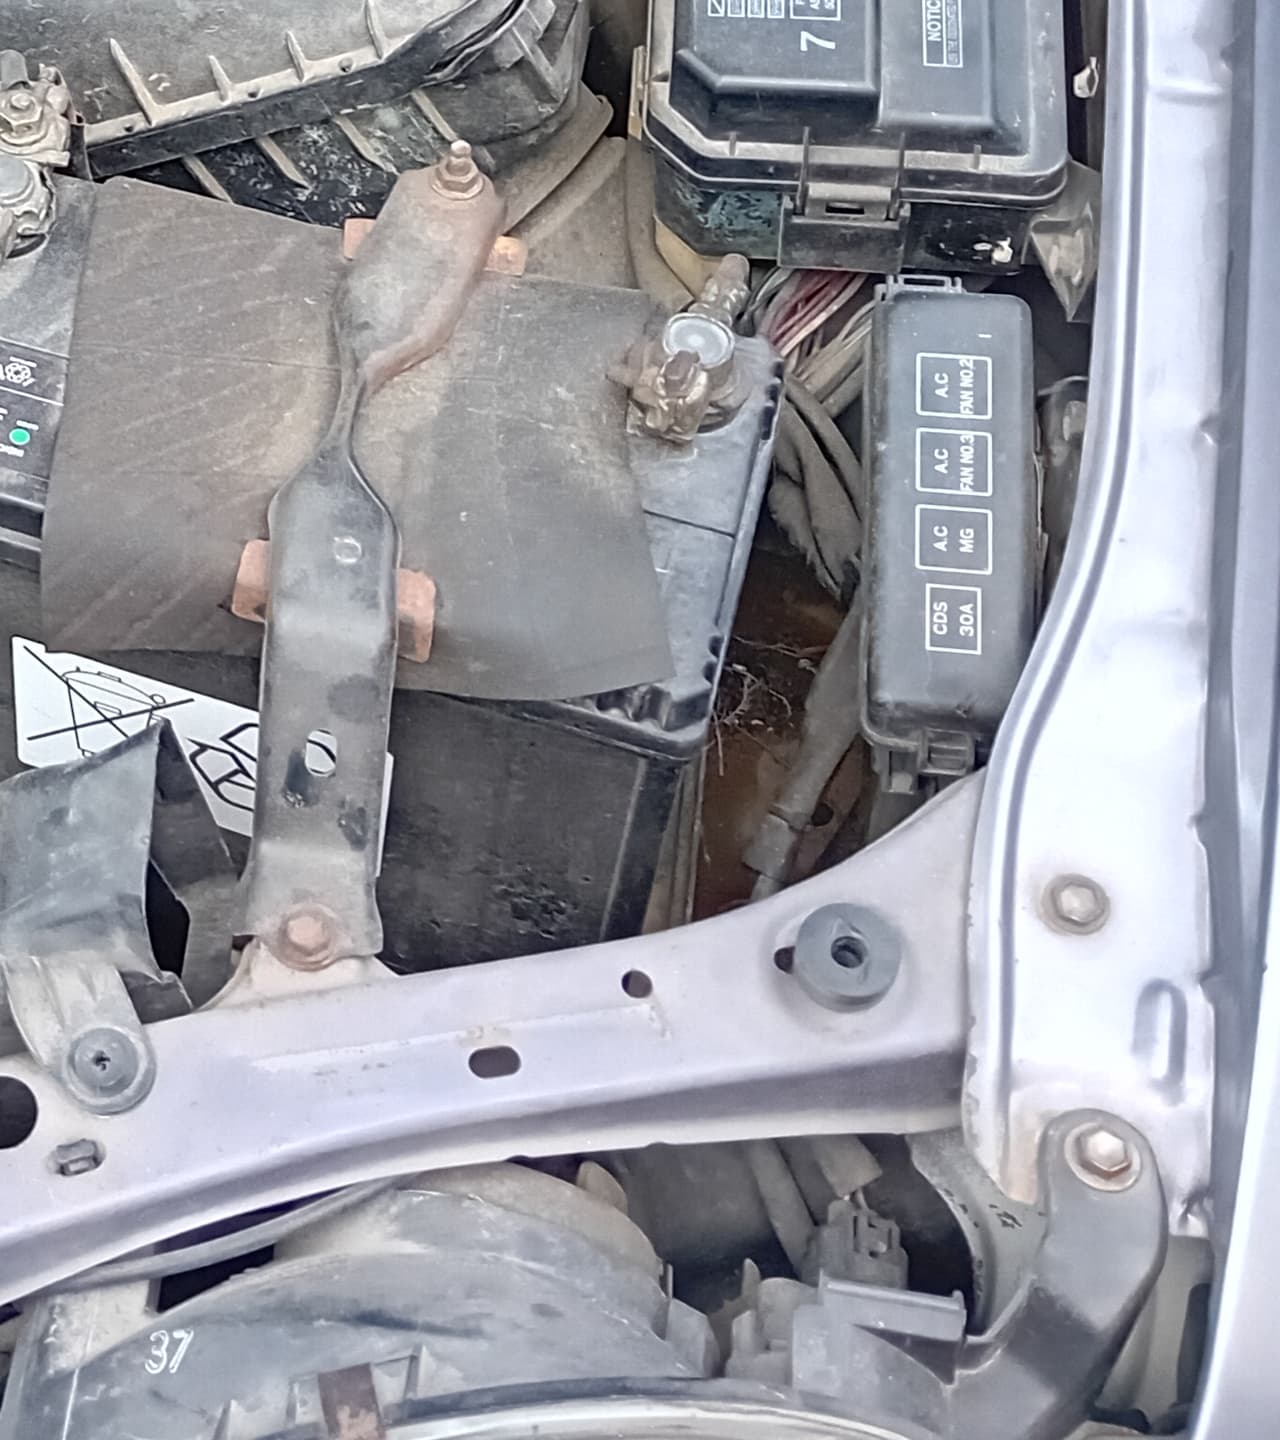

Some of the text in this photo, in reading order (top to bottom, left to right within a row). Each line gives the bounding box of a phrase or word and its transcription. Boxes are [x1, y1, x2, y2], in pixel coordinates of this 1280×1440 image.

[800, 30, 836, 52] 7
[935, 372, 949, 398] A.C
[959, 358, 975, 415] FAN NO.2
[934, 447, 949, 474] A.C
[960, 434, 975, 493] FAN NO.3
[934, 525, 949, 552] A.C
[959, 527, 975, 553] MG
[932, 600, 948, 635] CDS
[959, 602, 976, 637] 30A
[144, 1328, 194, 1375] 37
